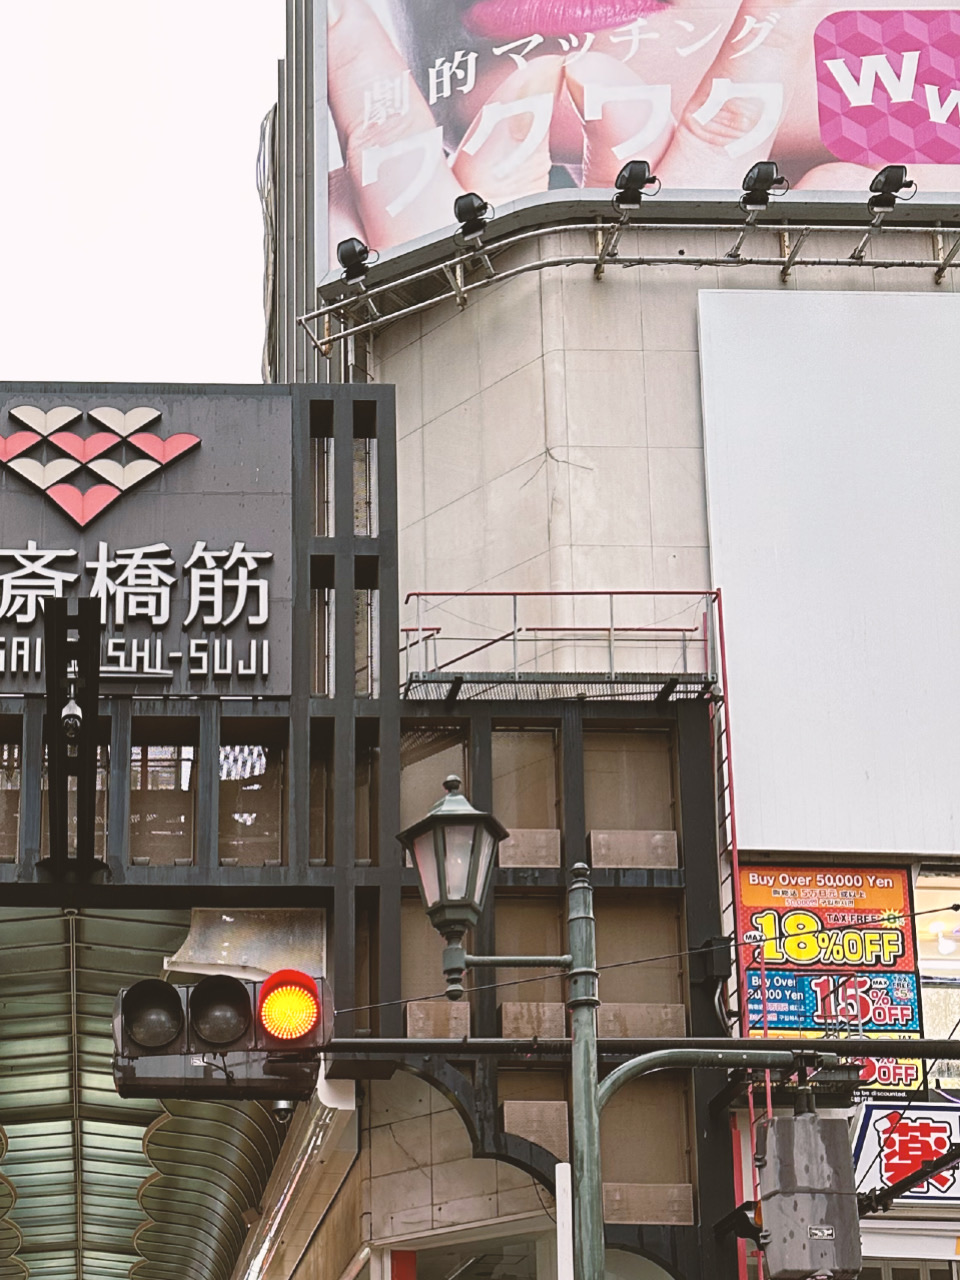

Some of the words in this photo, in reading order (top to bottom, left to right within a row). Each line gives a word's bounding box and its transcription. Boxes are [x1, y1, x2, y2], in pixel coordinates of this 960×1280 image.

[360, 12, 782, 132] 劇的マッチング
[361, 78, 784, 217] ワクワク
[749, 873, 775, 887] Buy
[778, 873, 811, 886] Over
[816, 874, 863, 887] 50,000
[867, 875, 893, 888] Yen
[826, 914, 847, 923] TAX
[849, 914, 877, 924] FREE
[785, 990, 804, 1001] Yen
[872, 1006, 914, 1025] OFF
[877, 1065, 918, 1085] OFF
[876, 1110, 952, 1190] 薬
